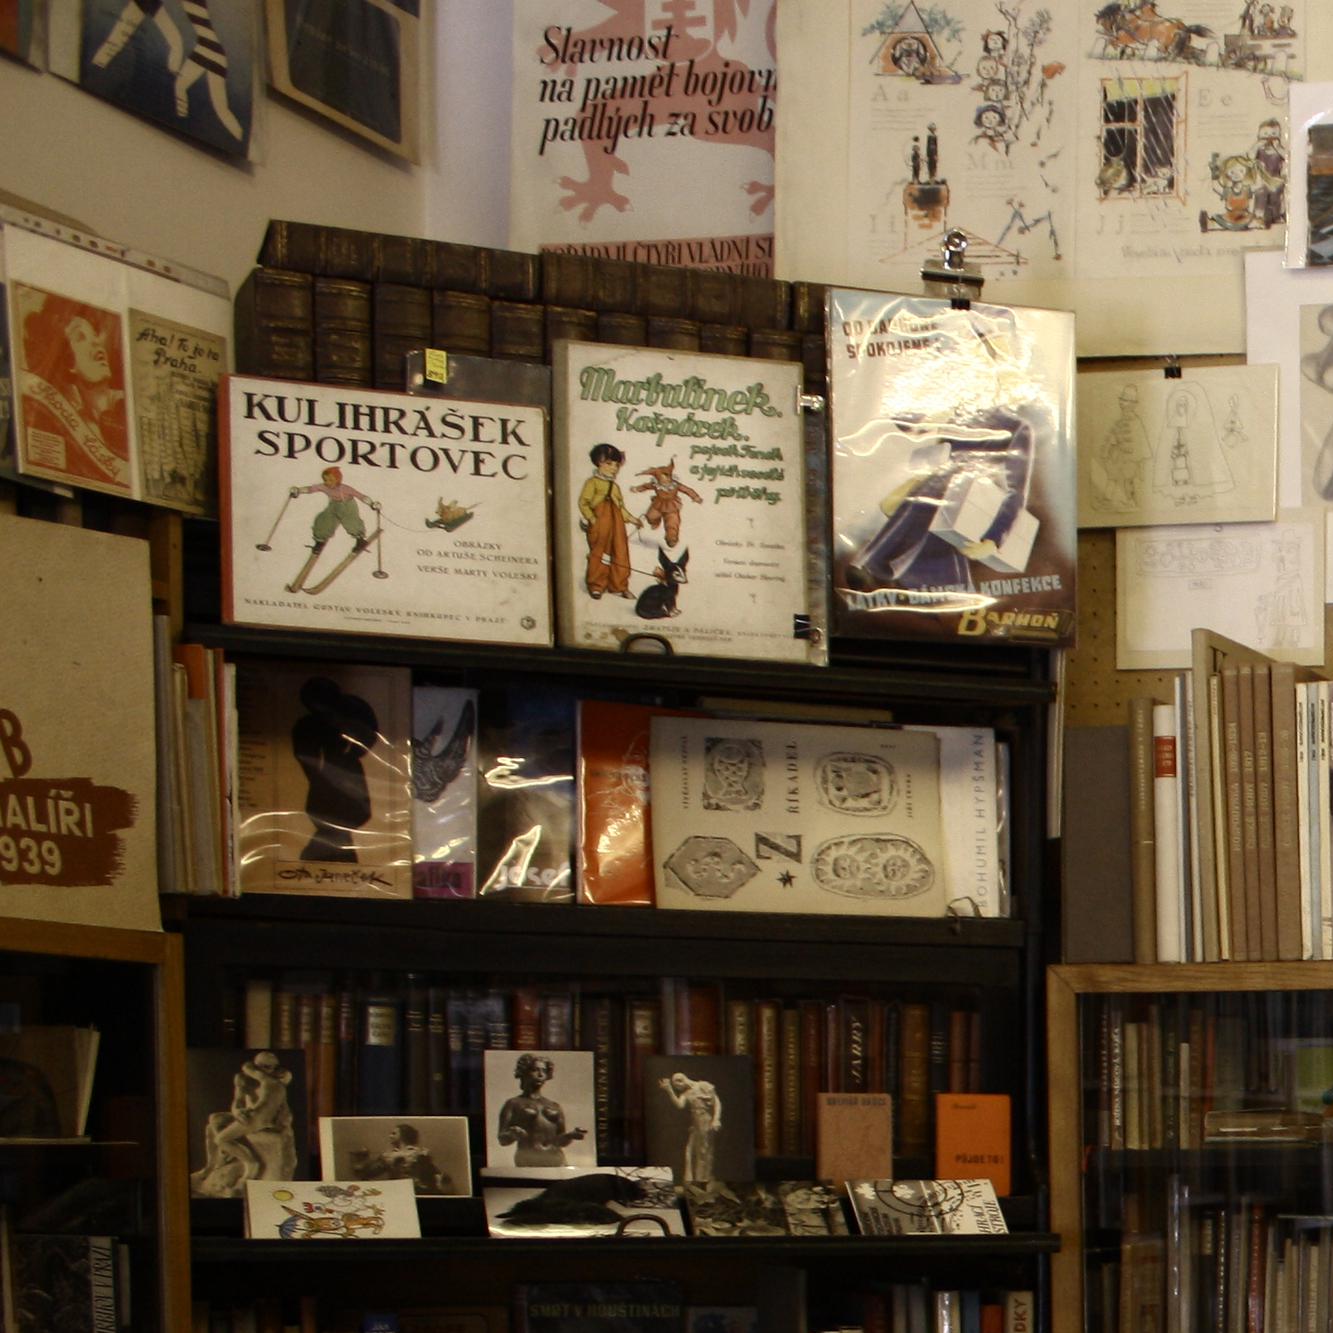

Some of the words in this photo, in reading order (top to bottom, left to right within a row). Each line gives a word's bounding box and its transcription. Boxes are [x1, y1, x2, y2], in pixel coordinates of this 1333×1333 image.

[541, 24, 680, 65] Slavnost
[540, 75, 576, 102] na
[540, 101, 656, 156] padlých
[665, 113, 699, 136] za
[243, 391, 534, 448] KULIHRÁŠEK
[254, 429, 534, 482] SPORTOVEC
[0, 788, 94, 839] ALÍŘI
[848, 1015, 863, 1084] JARRY
